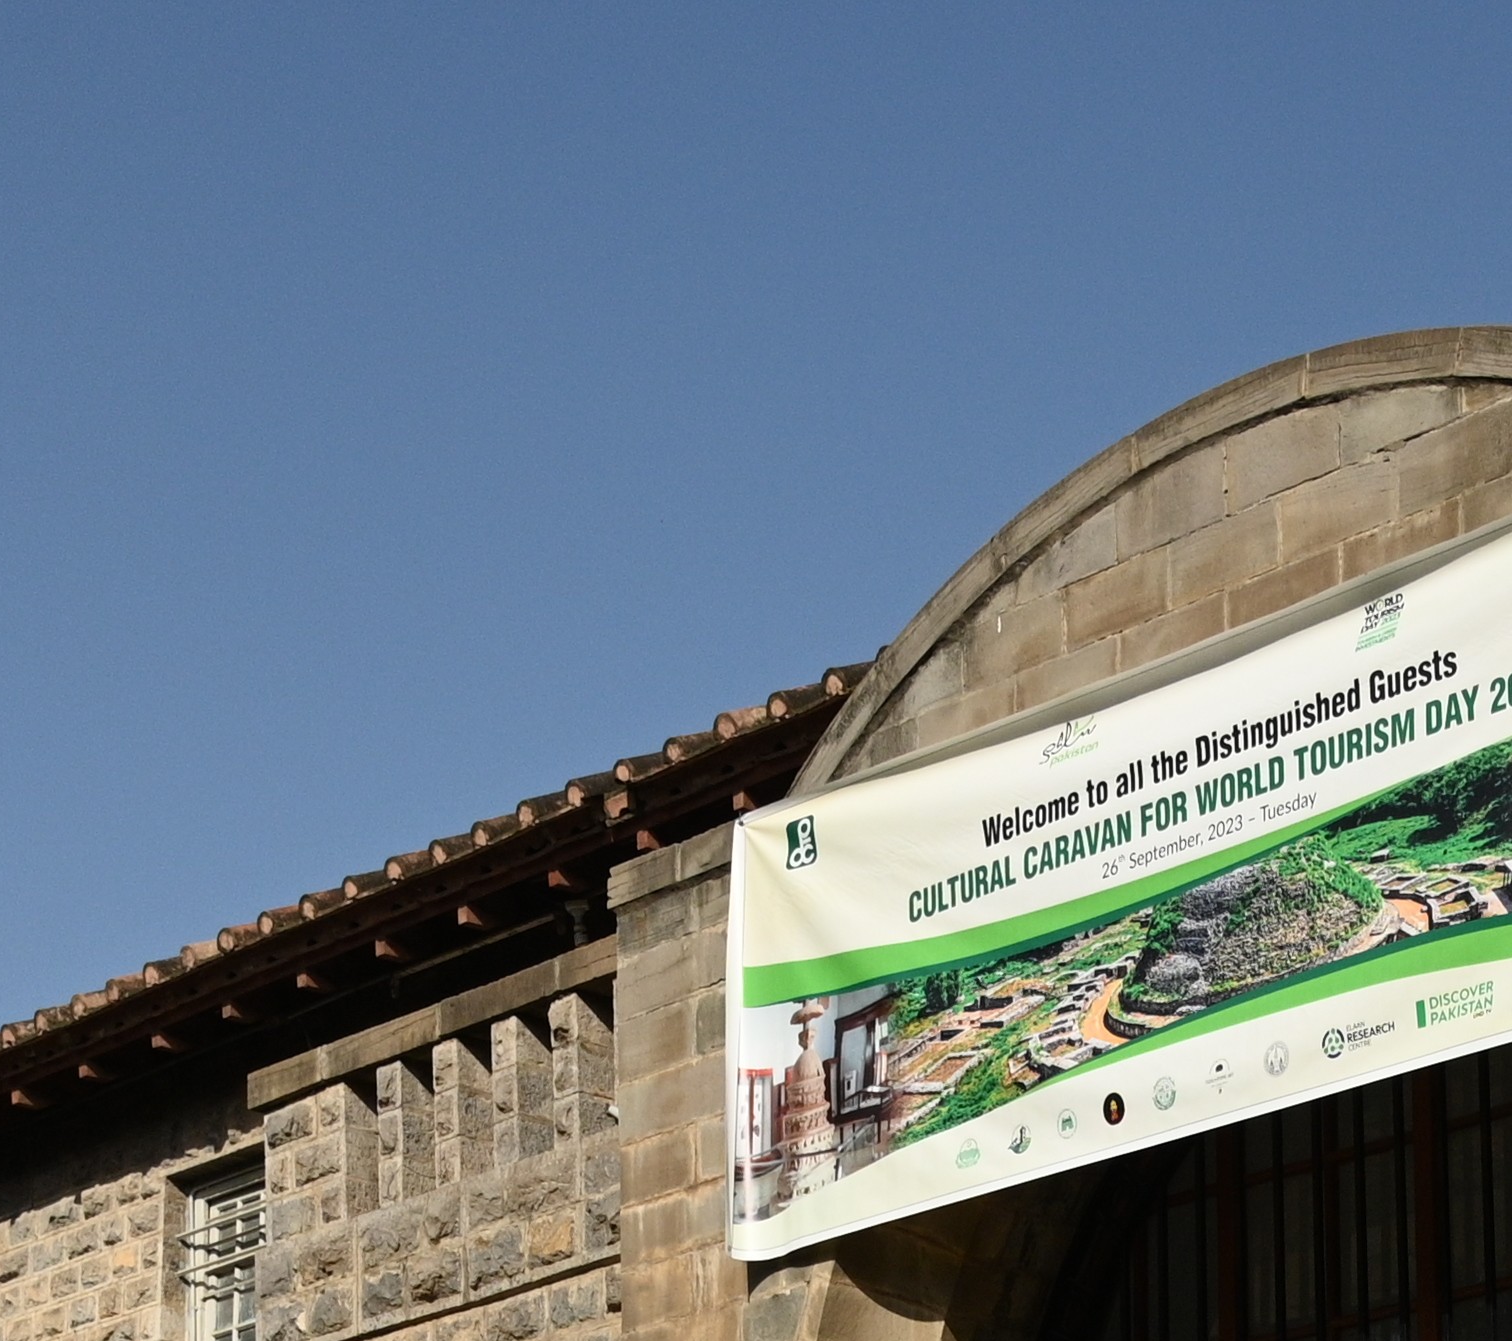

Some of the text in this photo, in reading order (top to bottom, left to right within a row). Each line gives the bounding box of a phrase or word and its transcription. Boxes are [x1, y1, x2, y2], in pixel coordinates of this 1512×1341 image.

[1365, 593, 1403, 615] WORLD
[982, 650, 1457, 847] Welcome to all the Distinguished Guests
[1049, 741, 1099, 768] pakistan
[908, 855, 1016, 923] CULTURAL
[1024, 810, 1132, 880] CARAVAN
[1140, 790, 1188, 837] FOR
[1195, 755, 1284, 816] WORLD
[1294, 708, 1415, 782] TOURISM
[1426, 685, 1479, 736] DAY
[1102, 792, 1317, 880] 26th September, 2023 Tuesday
[1429, 981, 1493, 1010] DISCOVER
[1431, 994, 1494, 1026] PAKISTAN
[1347, 1021, 1395, 1043] RESEARCH
